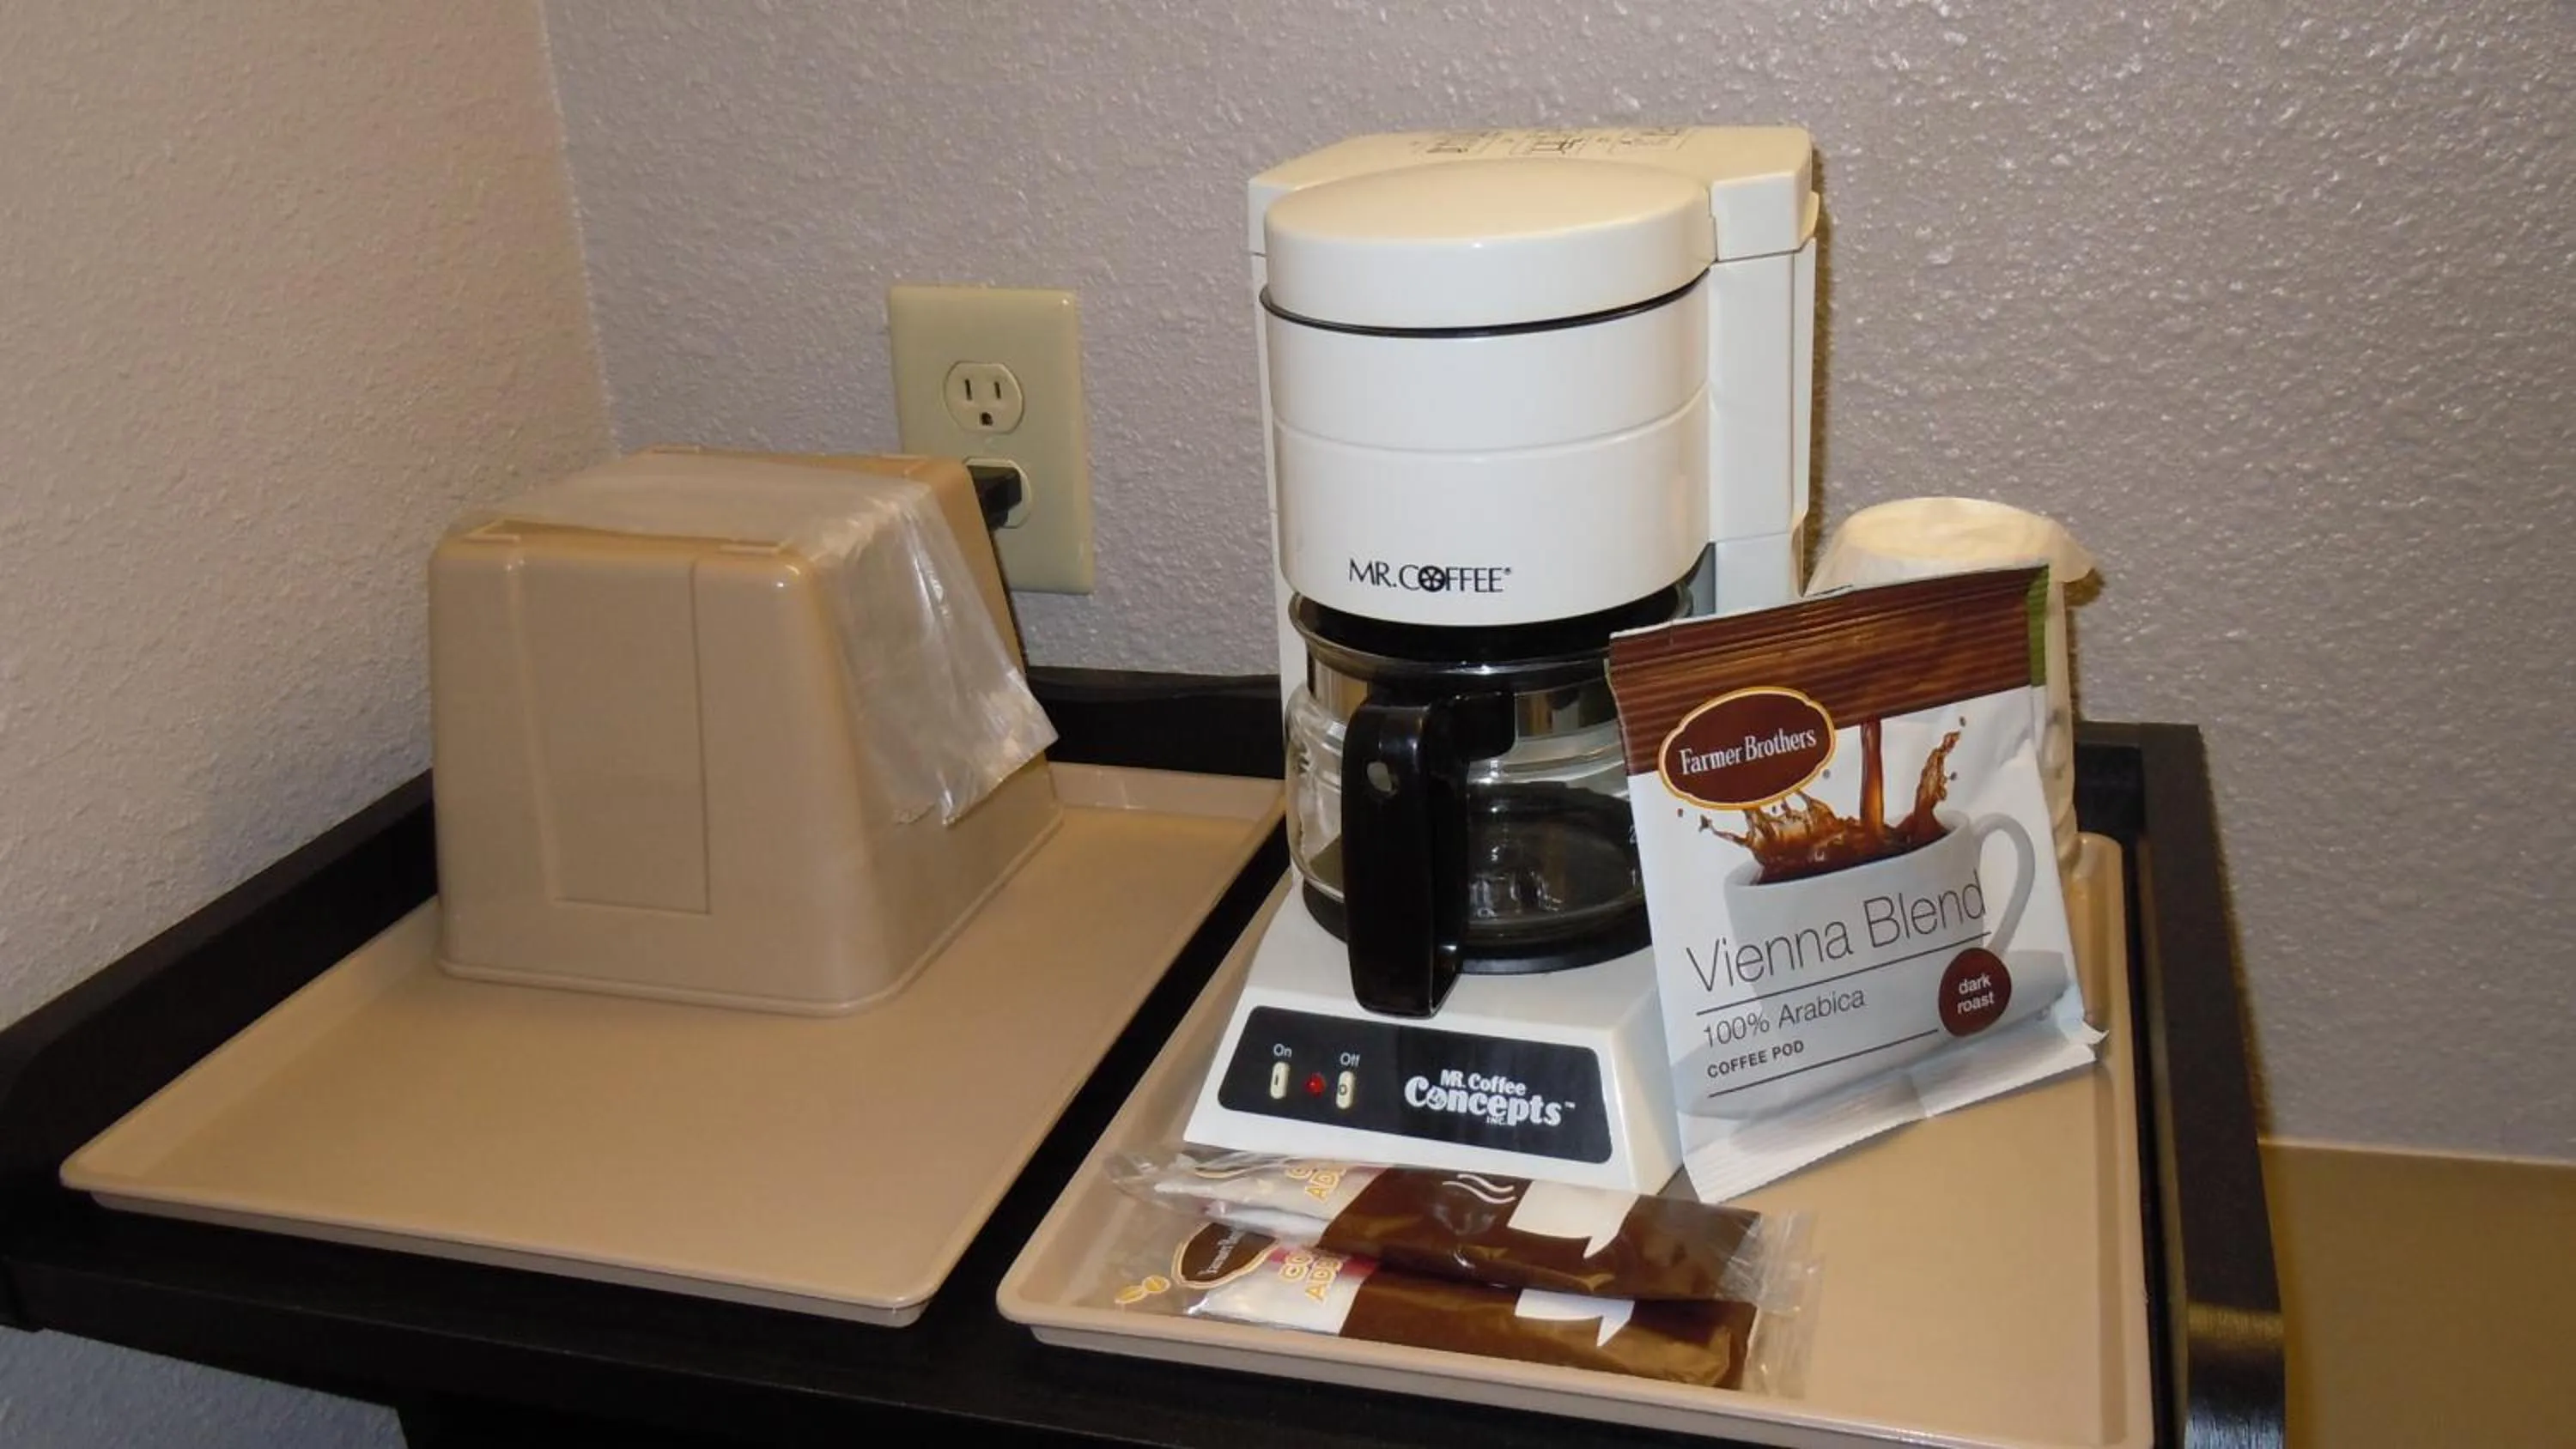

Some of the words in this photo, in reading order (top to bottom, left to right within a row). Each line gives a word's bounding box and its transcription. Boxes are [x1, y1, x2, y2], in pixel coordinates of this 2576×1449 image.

[1679, 748, 1742, 775] Farmer
[1745, 728, 1818, 761] Brothers
[1686, 920, 1853, 992] Vienna
[1862, 868, 1987, 949] Blend
[1958, 974, 1992, 996] dark
[1957, 991, 1996, 1015] roast
[1704, 1012, 1771, 1048] 100%
[1778, 990, 1866, 1029] Arabica
[1273, 1043, 1292, 1058] On
[1340, 1052, 1361, 1067] Off
[1707, 1049, 1768, 1078] COFFEE
[1771, 1040, 1805, 1060] POD
[1467, 1073, 1527, 1095] Coffee
